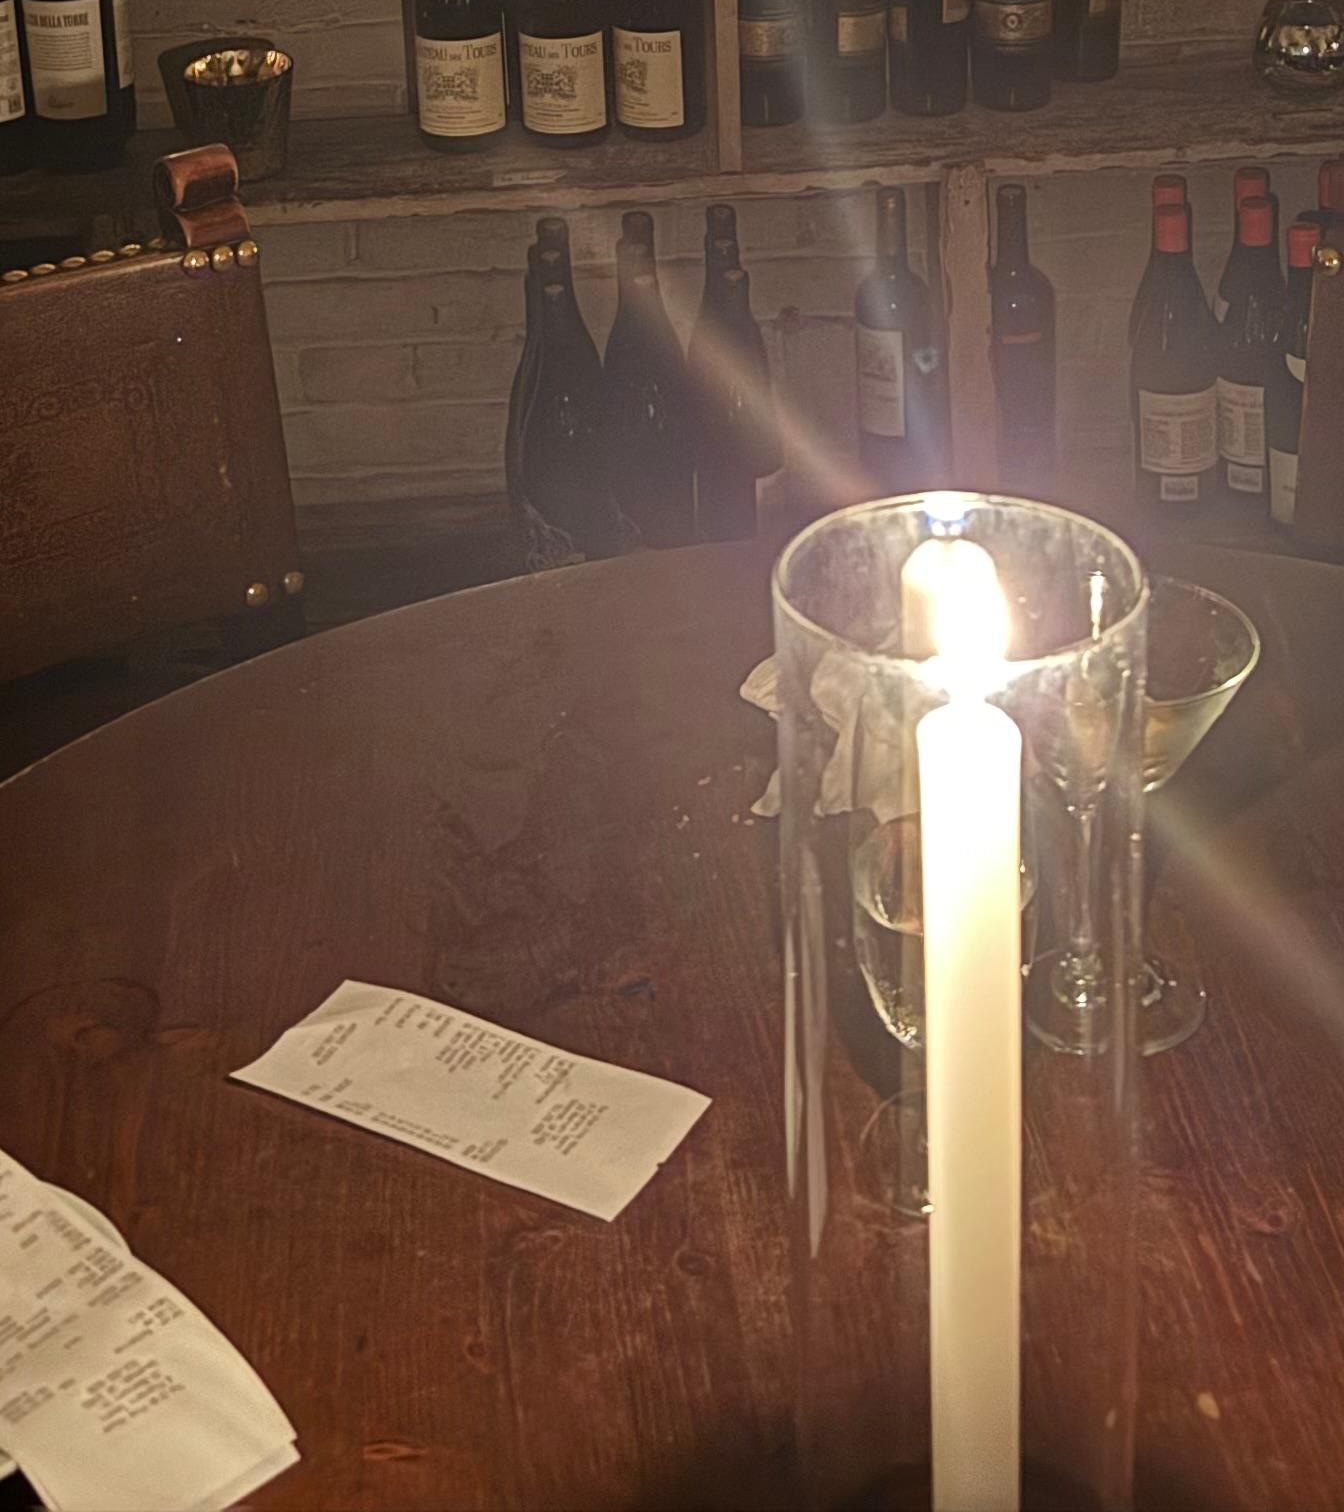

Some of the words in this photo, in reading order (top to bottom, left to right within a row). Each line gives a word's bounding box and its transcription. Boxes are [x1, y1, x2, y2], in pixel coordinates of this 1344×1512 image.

[464, 43, 498, 60] TOURS
[561, 41, 599, 58] TOURS
[634, 37, 672, 53] TOURS
